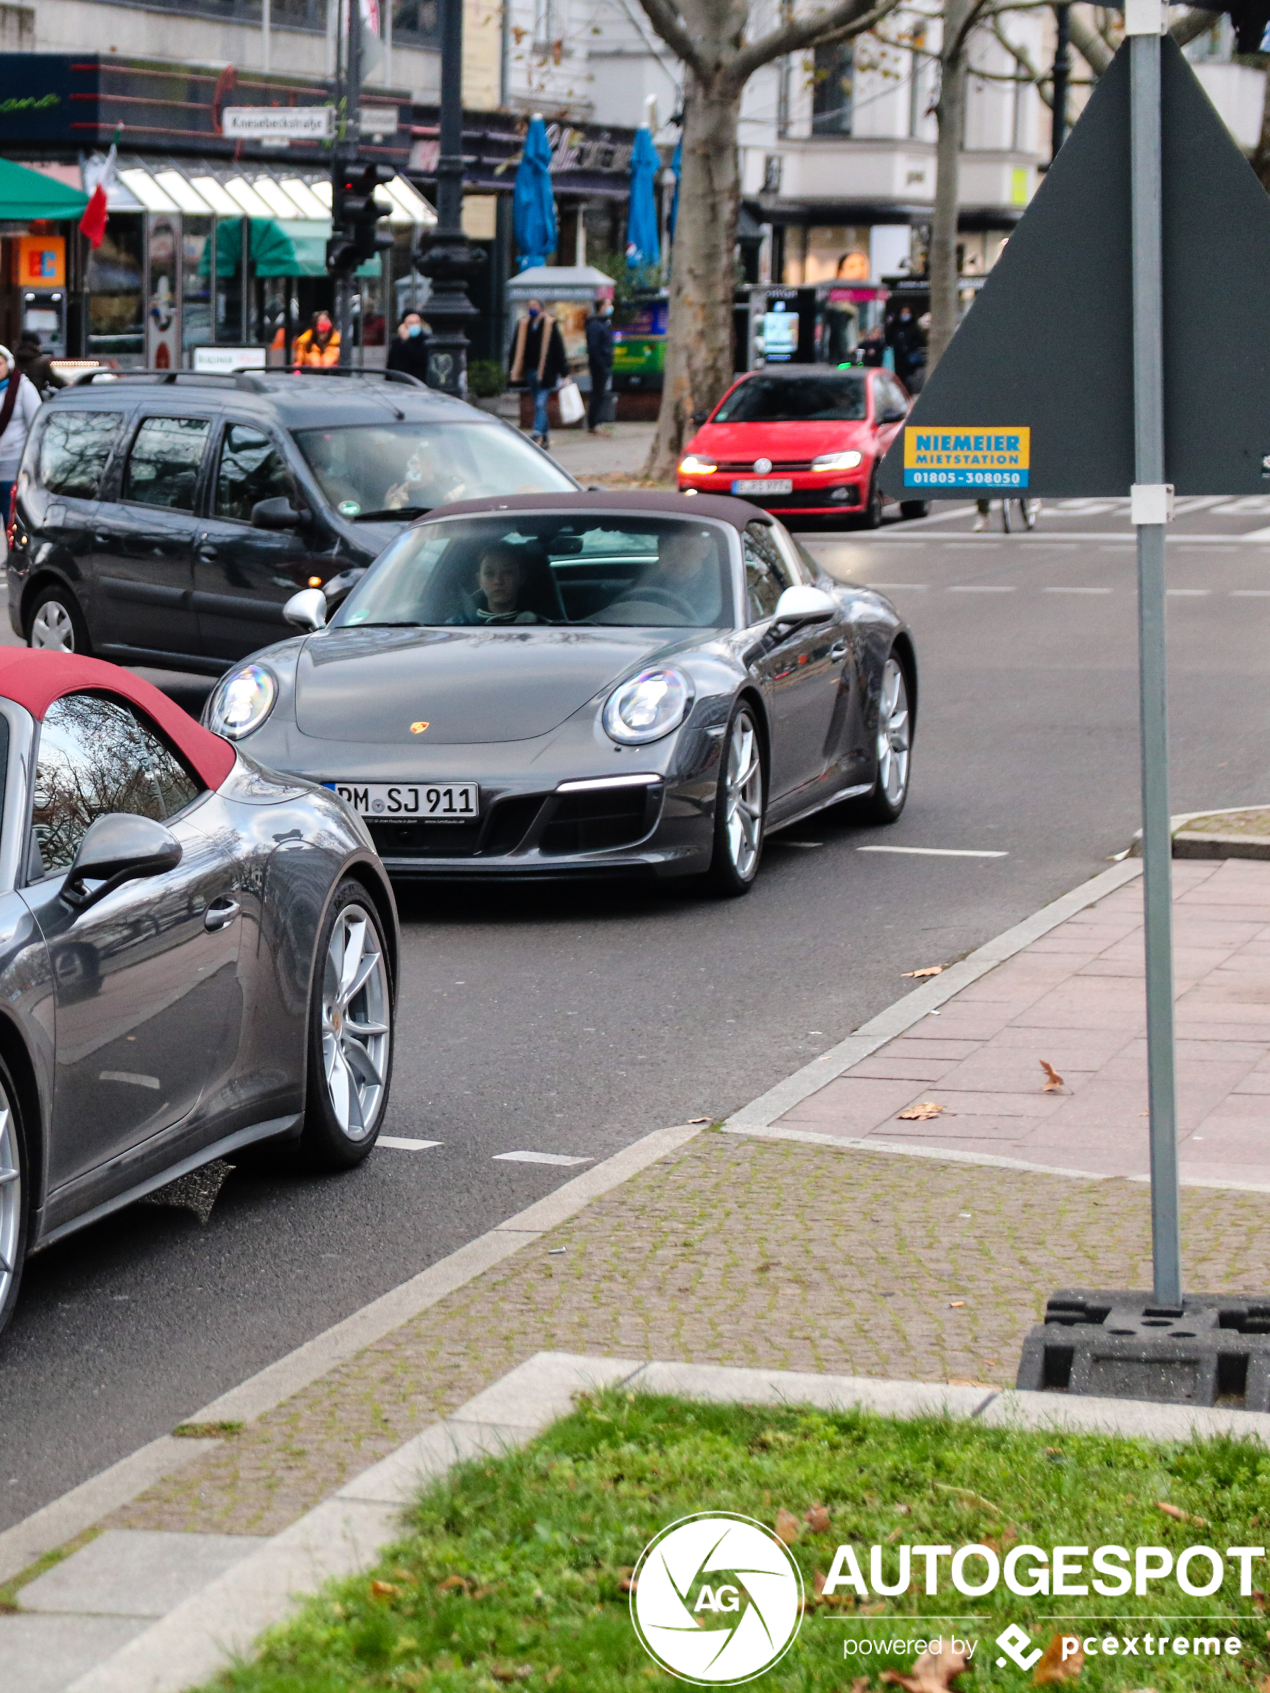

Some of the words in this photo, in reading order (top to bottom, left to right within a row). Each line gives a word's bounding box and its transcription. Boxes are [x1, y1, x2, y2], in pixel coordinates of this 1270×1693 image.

[231, 113, 323, 132] Knesebeckstraße
[29, 250, 57, 277] EC
[916, 435, 1021, 451] NIEMEIER
[916, 454, 1019, 464] MIETSTATION
[387, 787, 419, 812] SJ
[426, 788, 473, 812] 911
